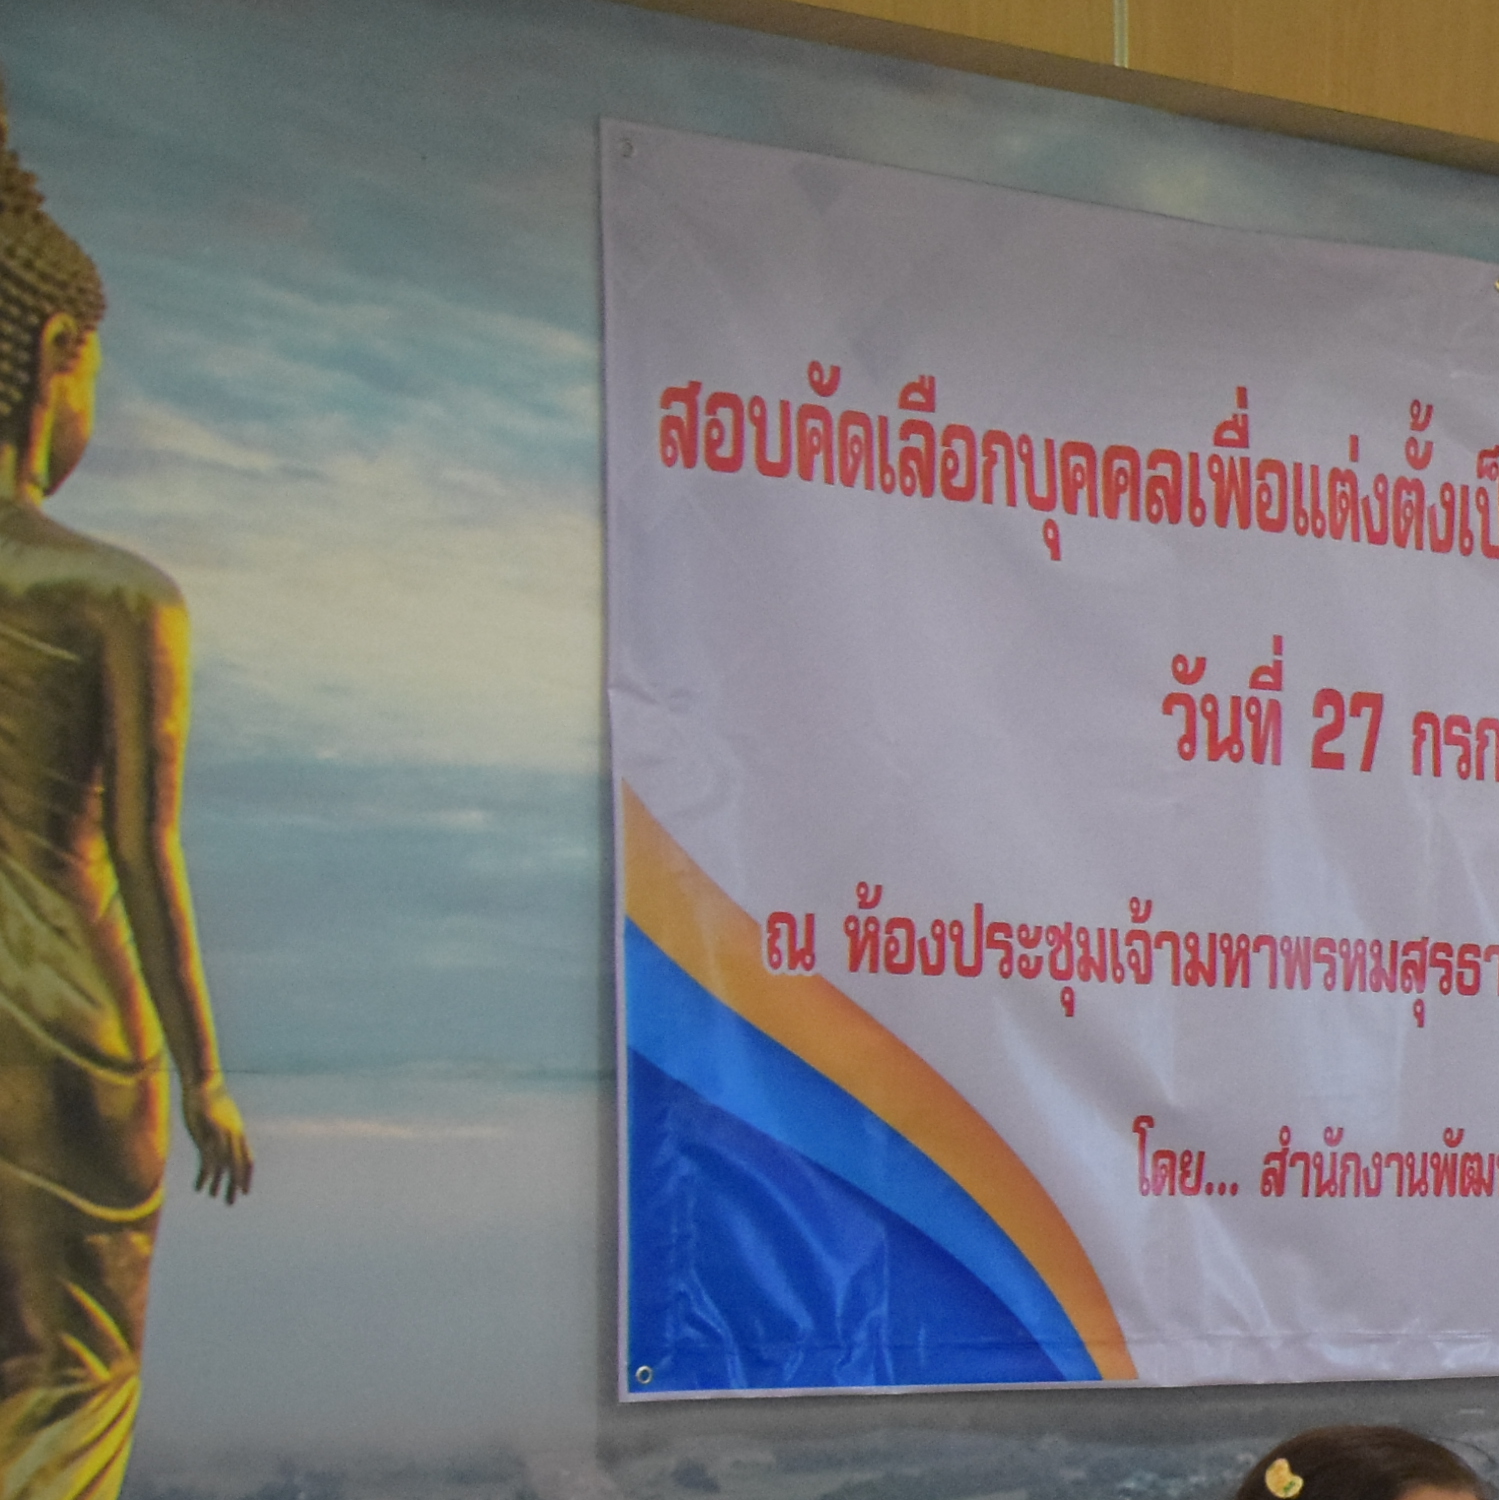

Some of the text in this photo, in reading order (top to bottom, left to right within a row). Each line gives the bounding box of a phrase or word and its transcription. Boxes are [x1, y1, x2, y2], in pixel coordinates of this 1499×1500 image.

[1161, 634, 1284, 766] วันที่
[1310, 688, 1385, 773] 27
[766, 911, 816, 971] ณ
[1132, 1114, 1240, 1197] โดย...
